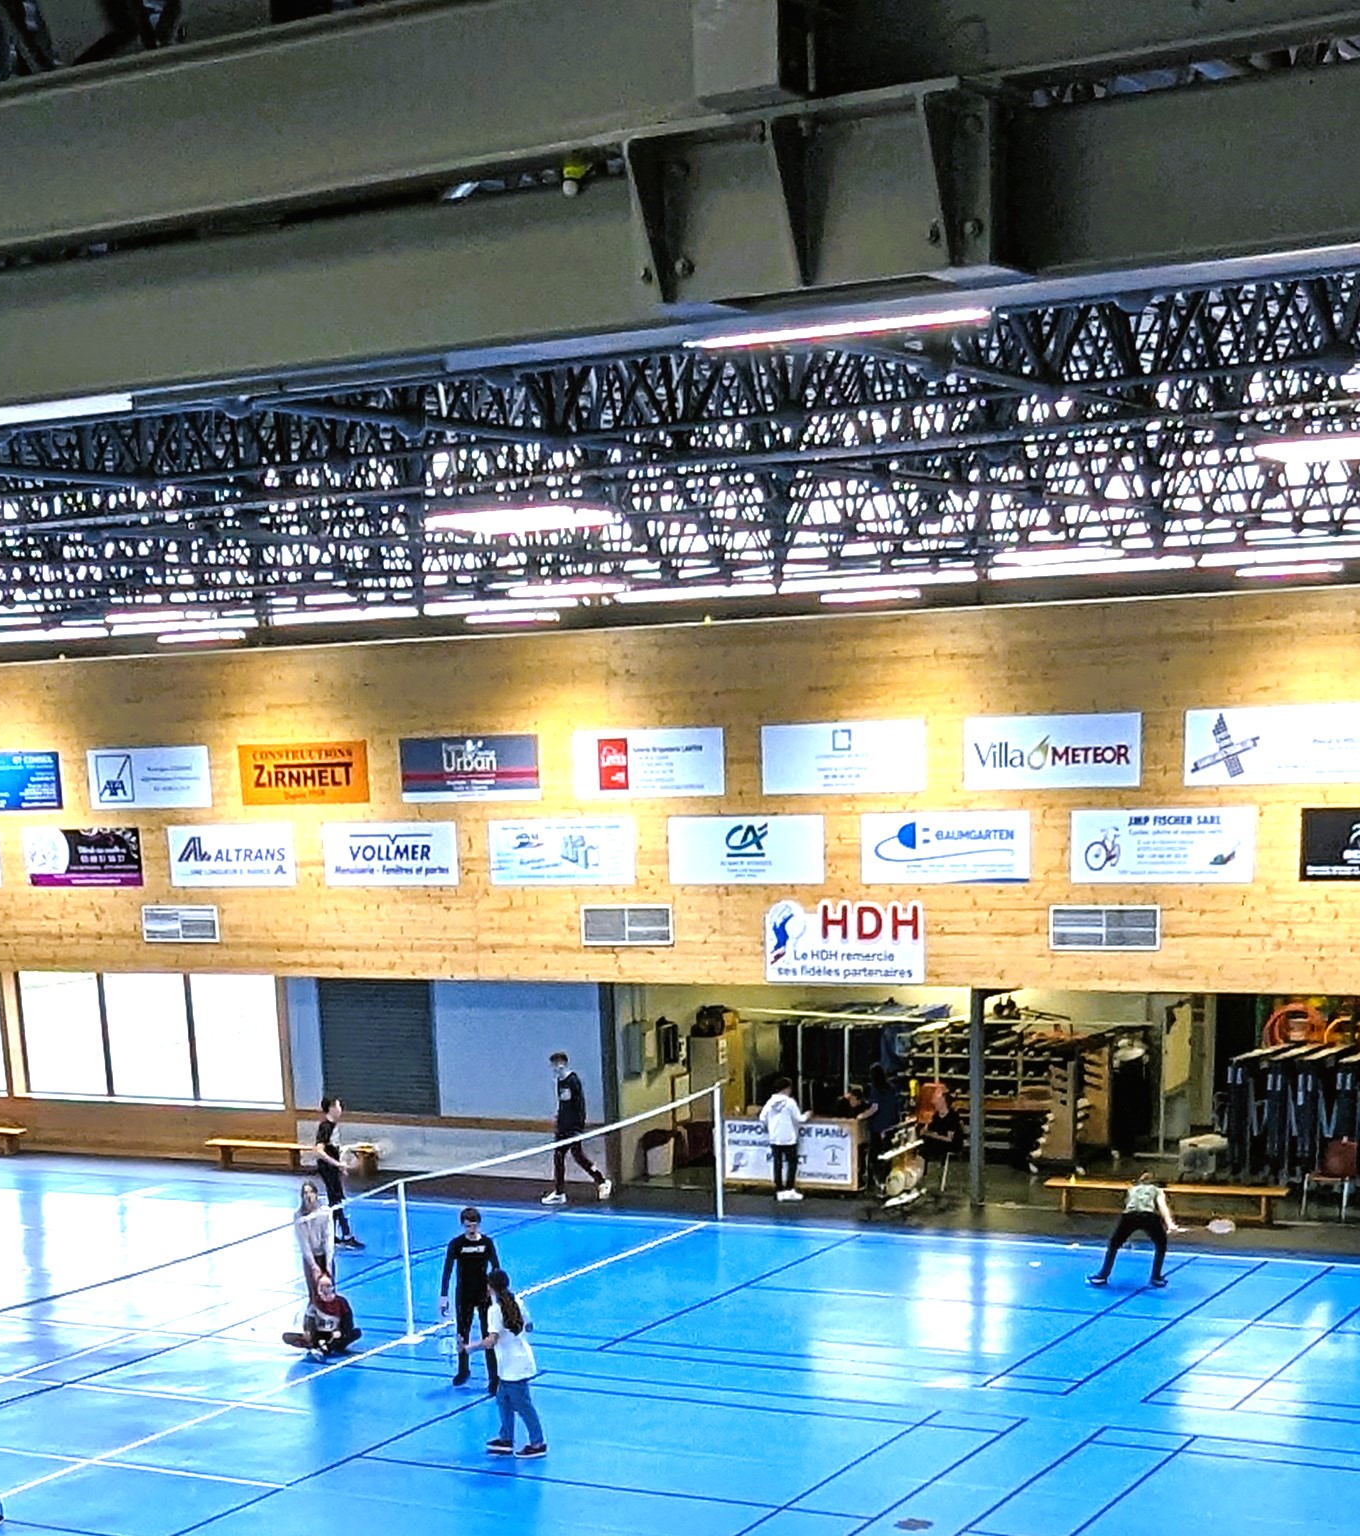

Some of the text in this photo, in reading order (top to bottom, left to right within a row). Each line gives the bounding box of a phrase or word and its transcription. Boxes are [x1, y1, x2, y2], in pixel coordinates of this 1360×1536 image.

[252, 748, 354, 761] CONSTRUCTIONS
[442, 743, 498, 772] Urban
[974, 741, 1131, 769] Villa METEOR
[253, 762, 354, 788] ZIRNHELT
[1153, 815, 1193, 826] FISCHER
[936, 828, 1015, 842] BAUMGARTEN
[213, 847, 286, 862] ALTRANS
[349, 844, 432, 861] VOLLMER
[334, 865, 375, 874] Menuiserie
[382, 864, 414, 875] Fenêtres
[424, 866, 450, 877] portes
[821, 904, 919, 941] HDH
[794, 950, 895, 962] Le HDH remercie
[777, 964, 913, 980] ses fidèles partenaires
[727, 1124, 770, 1135] SUPPO
